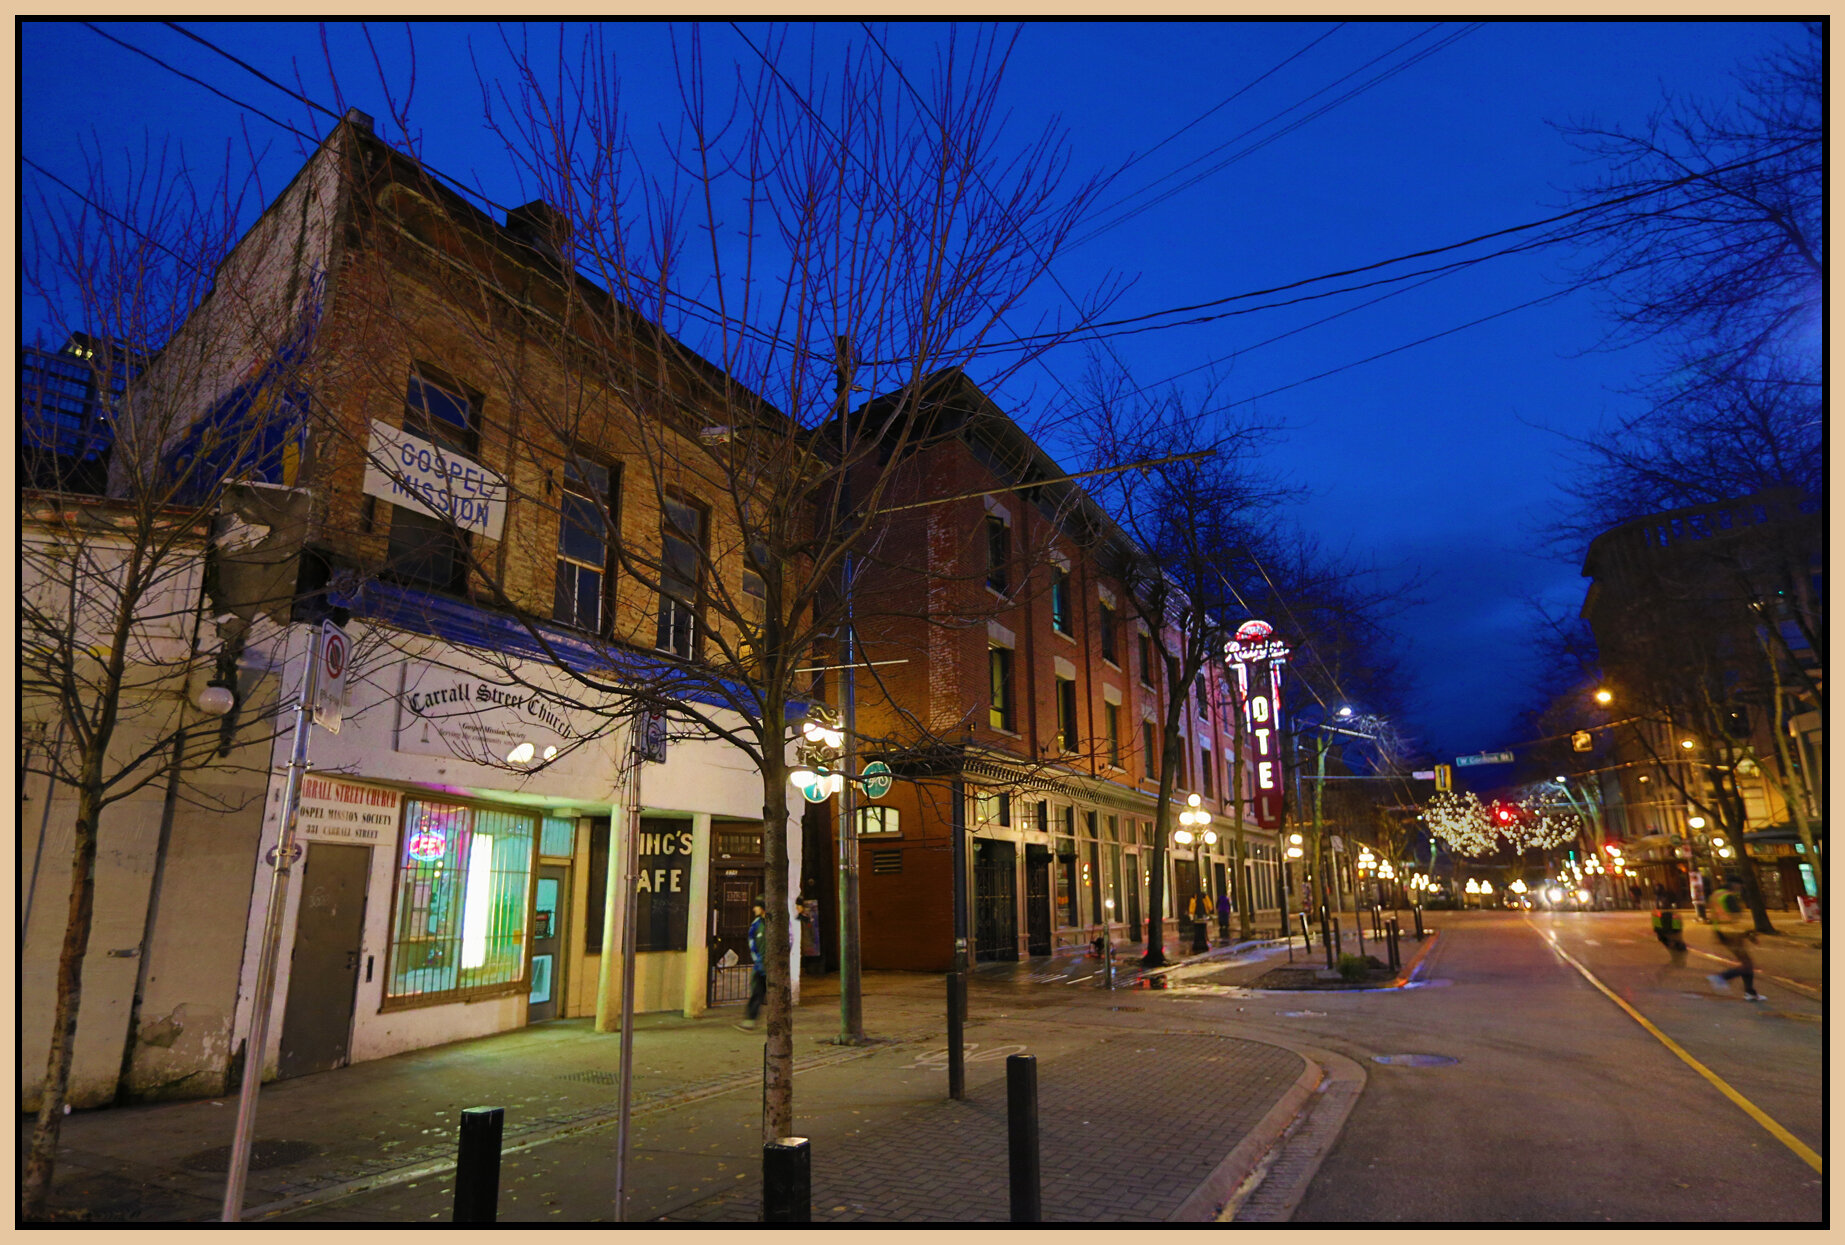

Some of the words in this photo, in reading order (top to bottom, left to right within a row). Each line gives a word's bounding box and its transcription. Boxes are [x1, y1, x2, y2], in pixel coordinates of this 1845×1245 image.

[401, 443, 492, 498] GOSPEL
[392, 471, 489, 527] MISSION
[408, 683, 470, 713] Carrall
[476, 684, 524, 709] Street
[527, 698, 572, 739] Church
[1251, 668, 1276, 821] OTEL
[302, 779, 332, 800] ARRALL
[335, 784, 364, 804] STREET
[366, 788, 397, 808] CHURCH
[300, 806, 324, 819] OSPEL
[328, 809, 358, 822] MISSION
[362, 812, 392, 826] SOCIETY
[306, 824, 319, 834] 331
[355, 828, 379, 839] STREET
[638, 830, 693, 856] ING'S
[637, 869, 682, 893] AFE
